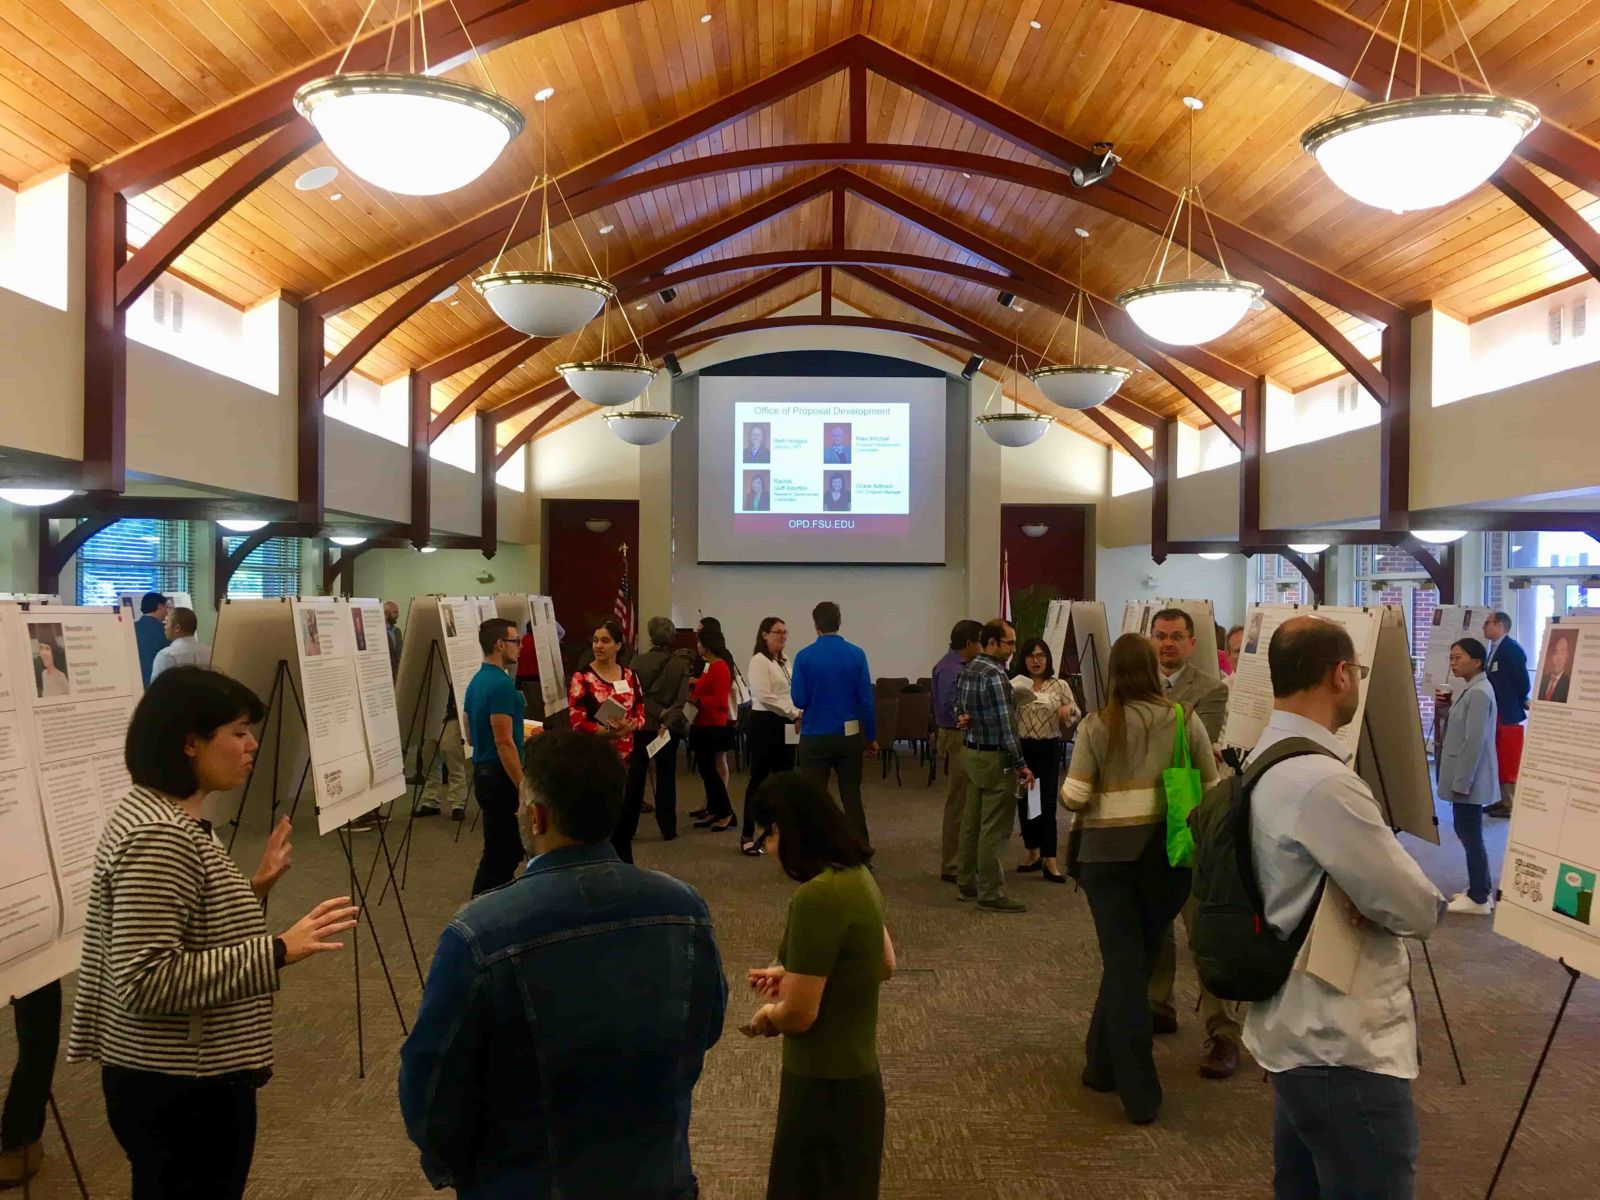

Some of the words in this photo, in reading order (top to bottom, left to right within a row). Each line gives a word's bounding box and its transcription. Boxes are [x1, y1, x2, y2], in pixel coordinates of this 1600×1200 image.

[754, 406, 780, 415] Office
[781, 406, 791, 415] of
[792, 406, 831, 417] Proposal
[833, 406, 891, 417] Development
[788, 519, 855, 529] OPD.FSU.EDU
